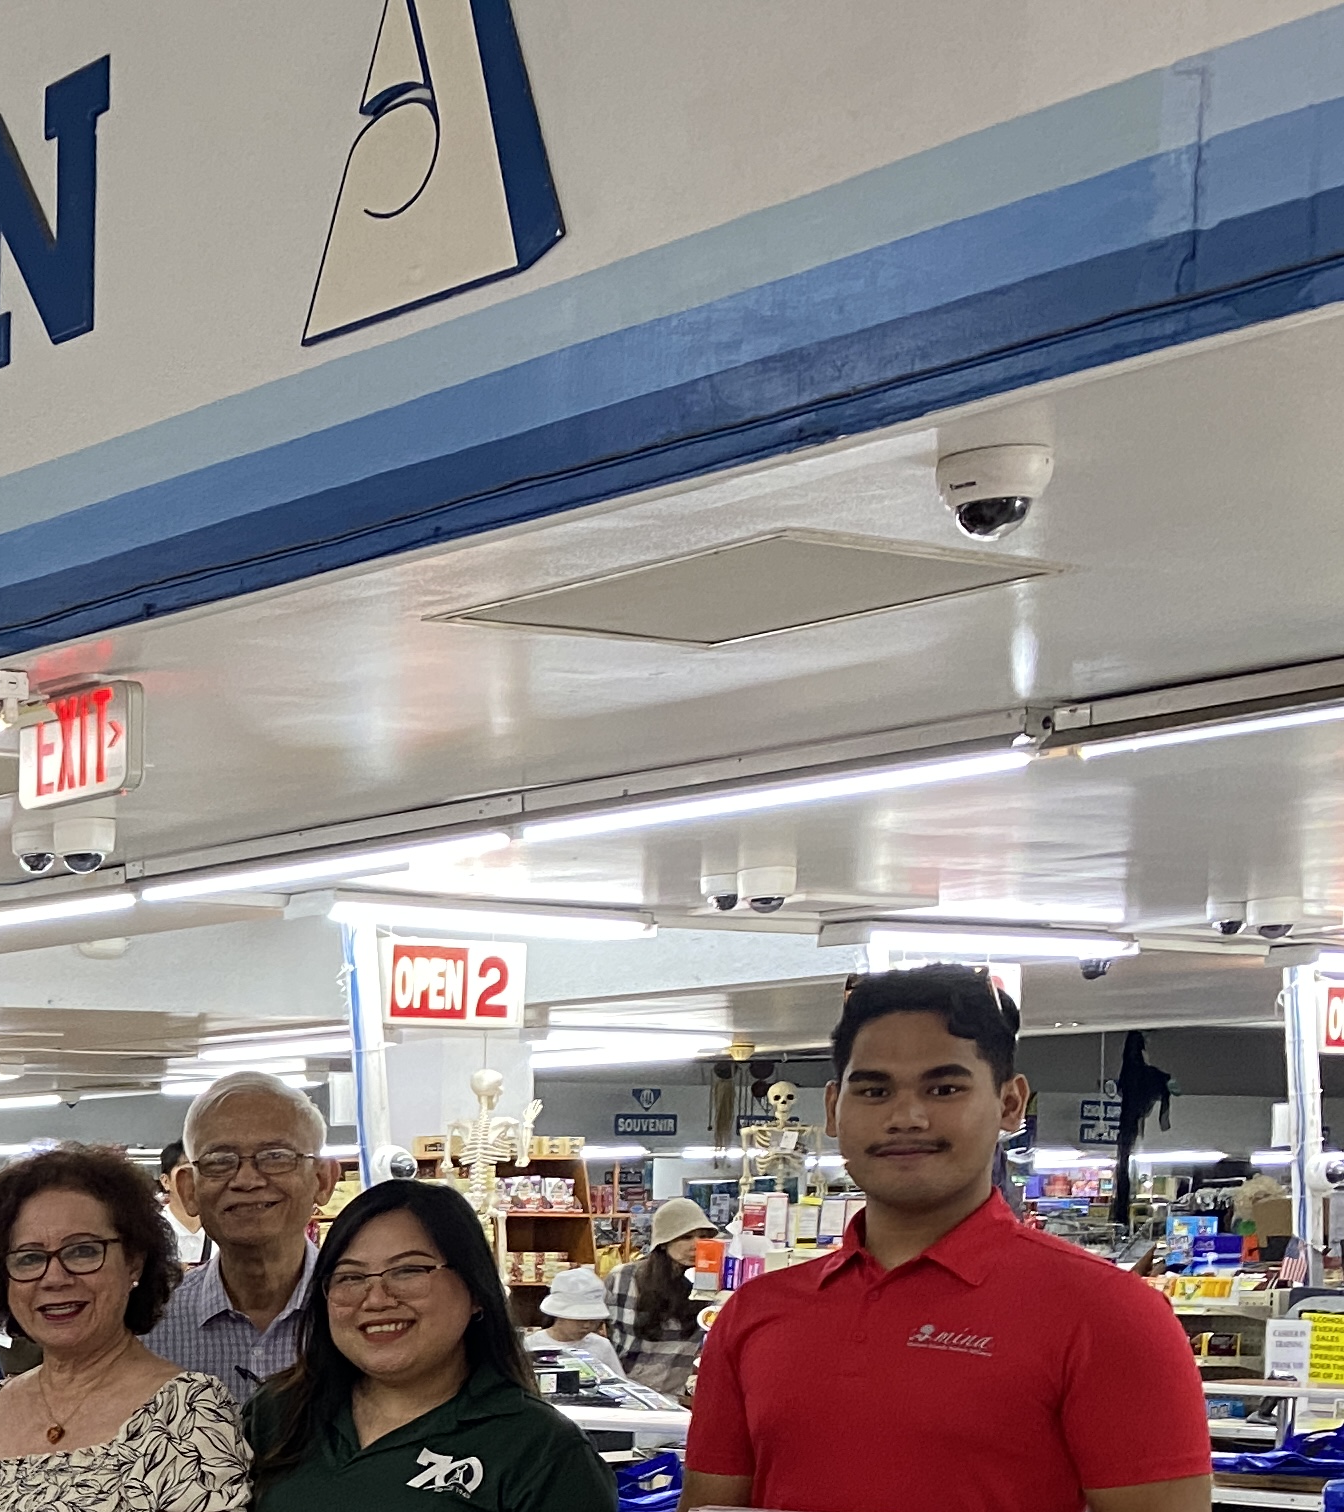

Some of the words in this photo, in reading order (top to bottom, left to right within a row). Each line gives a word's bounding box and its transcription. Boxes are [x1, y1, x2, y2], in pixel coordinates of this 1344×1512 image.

[35, 687, 113, 797] EXIT
[395, 956, 464, 1010] OPEN
[475, 956, 509, 1018] 2
[618, 1117, 675, 1132] SOUVENIR
[934, 1327, 994, 1349] mina
[406, 1447, 483, 1494] 70
